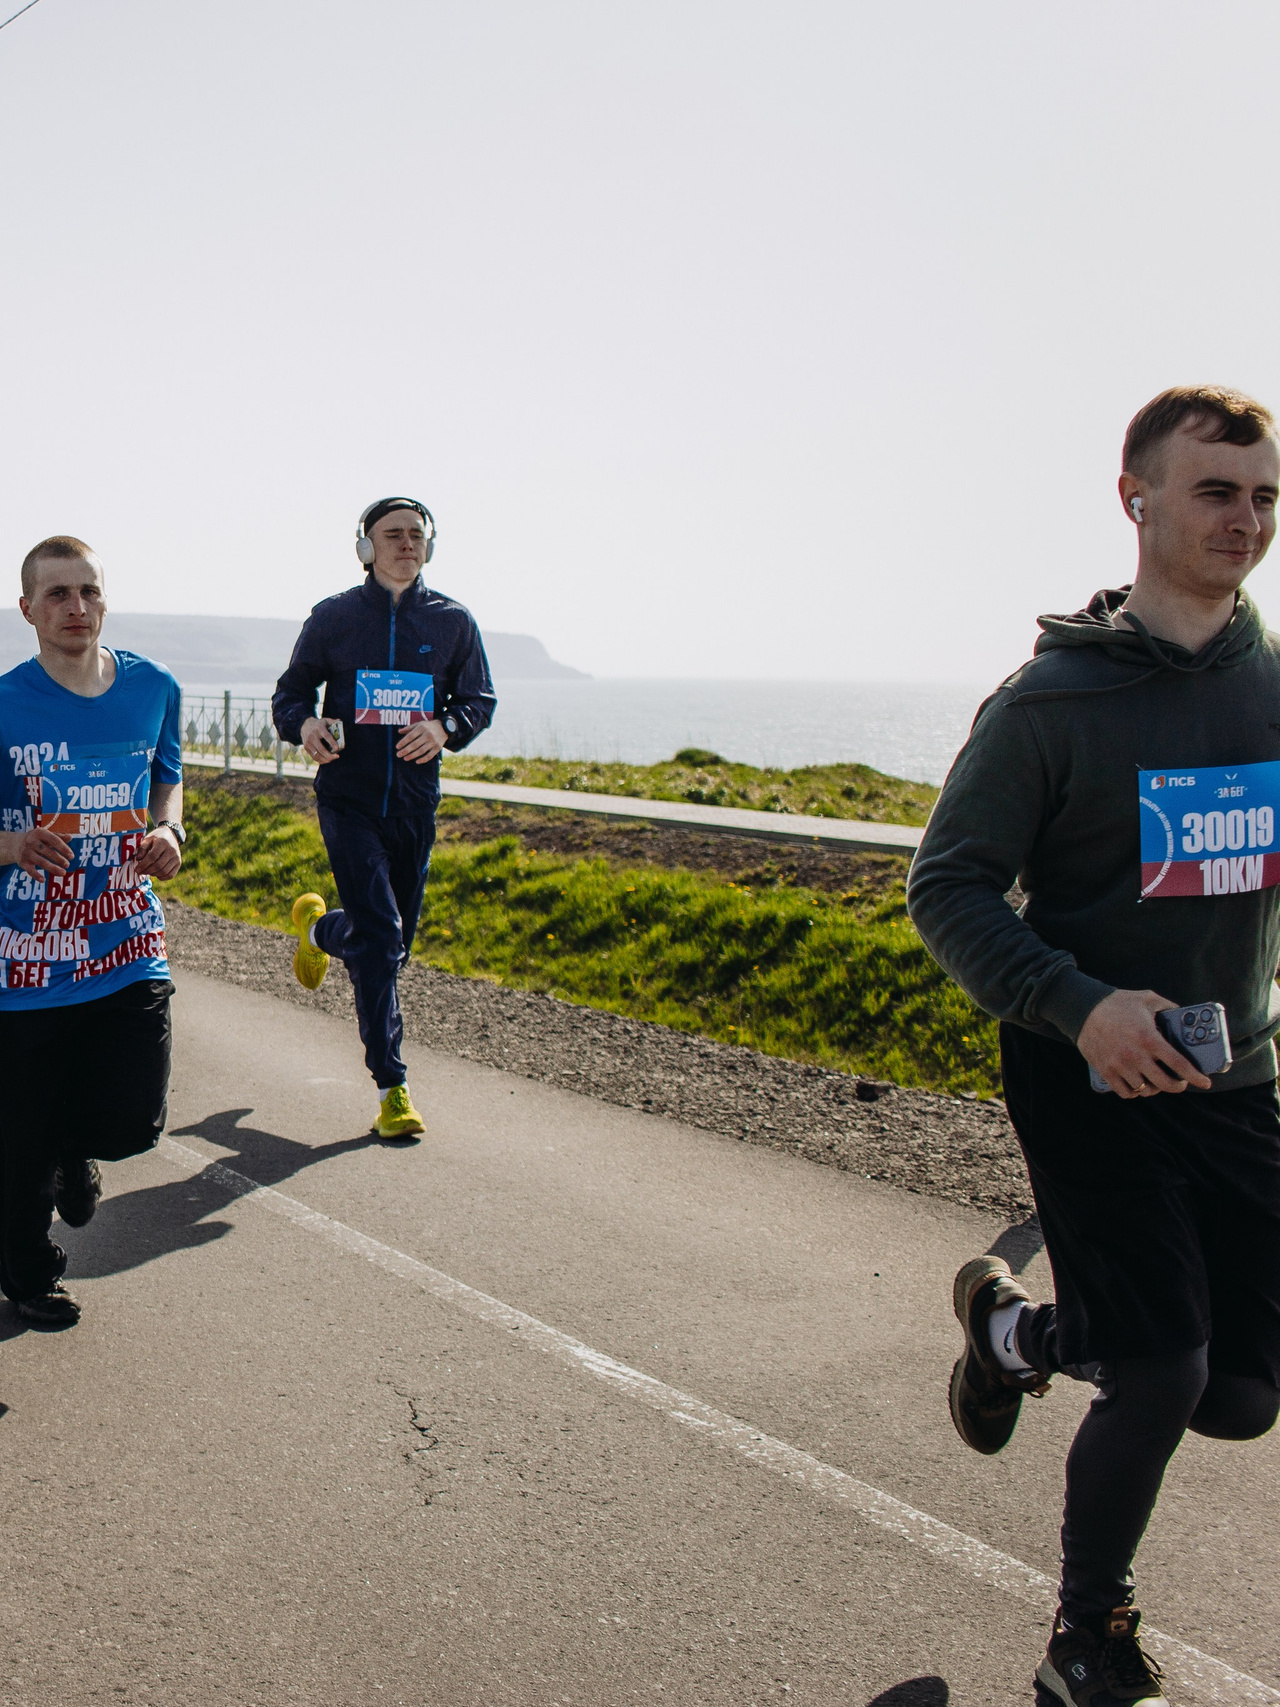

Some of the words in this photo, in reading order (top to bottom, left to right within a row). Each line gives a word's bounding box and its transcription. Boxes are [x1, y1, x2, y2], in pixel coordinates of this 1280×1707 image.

[373, 688, 420, 708] 30022
[1169, 776, 1195, 787] ПСБ
[67, 782, 131, 810] 20059
[1182, 806, 1274, 853] 30019
